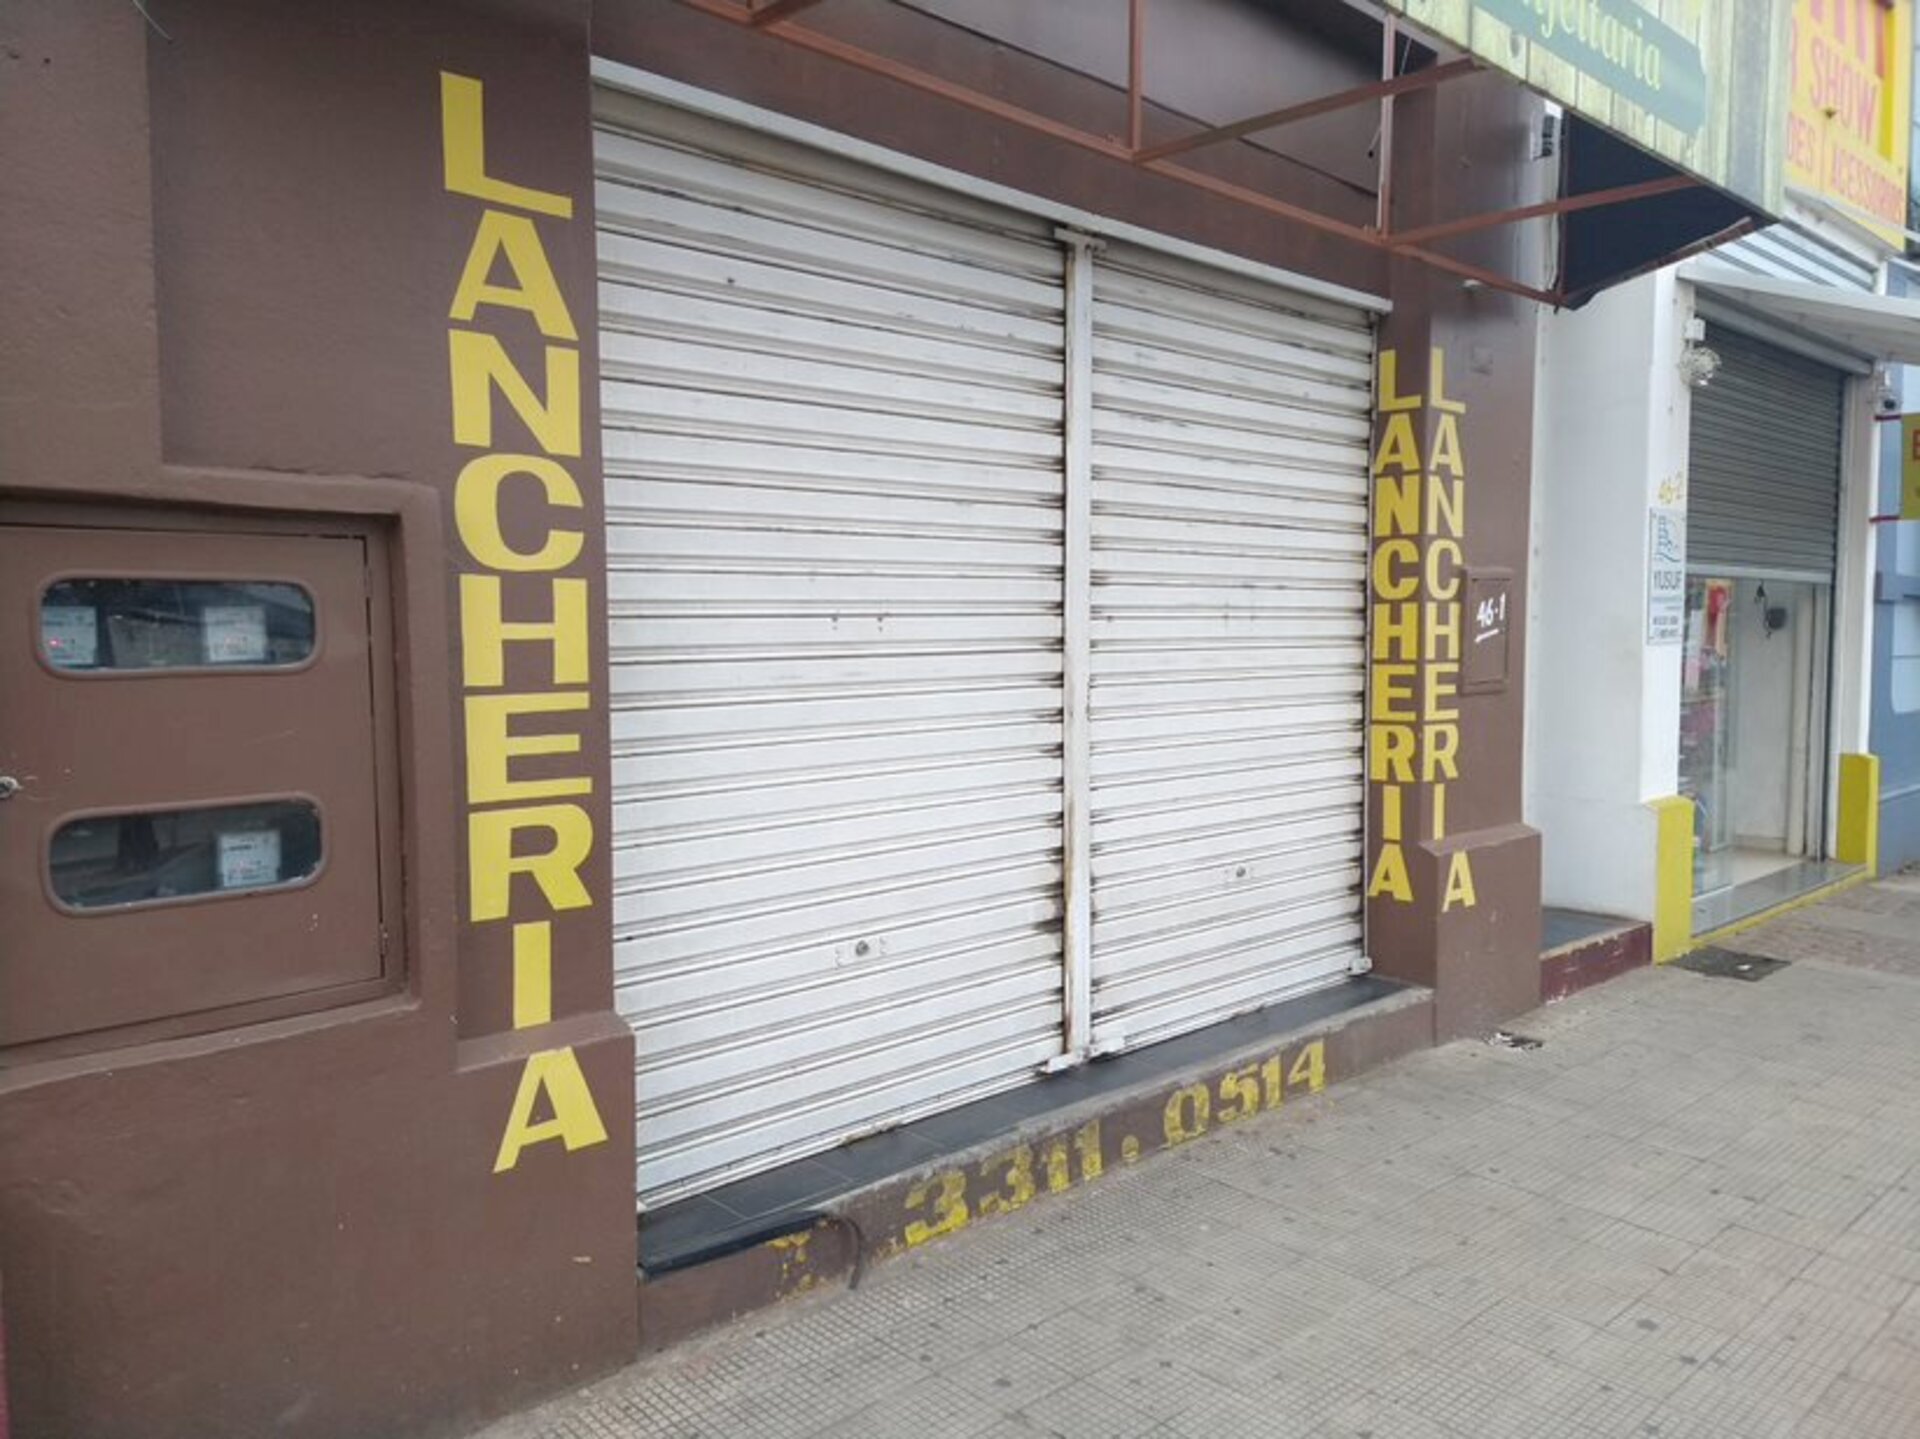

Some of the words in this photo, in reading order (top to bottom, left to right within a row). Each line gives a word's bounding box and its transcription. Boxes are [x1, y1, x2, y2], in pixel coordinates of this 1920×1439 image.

[440, 70, 608, 1174] LANCHERIA
[1366, 348, 1422, 902] LANCHERIA
[1422, 346, 1476, 913] LANCHERIA
